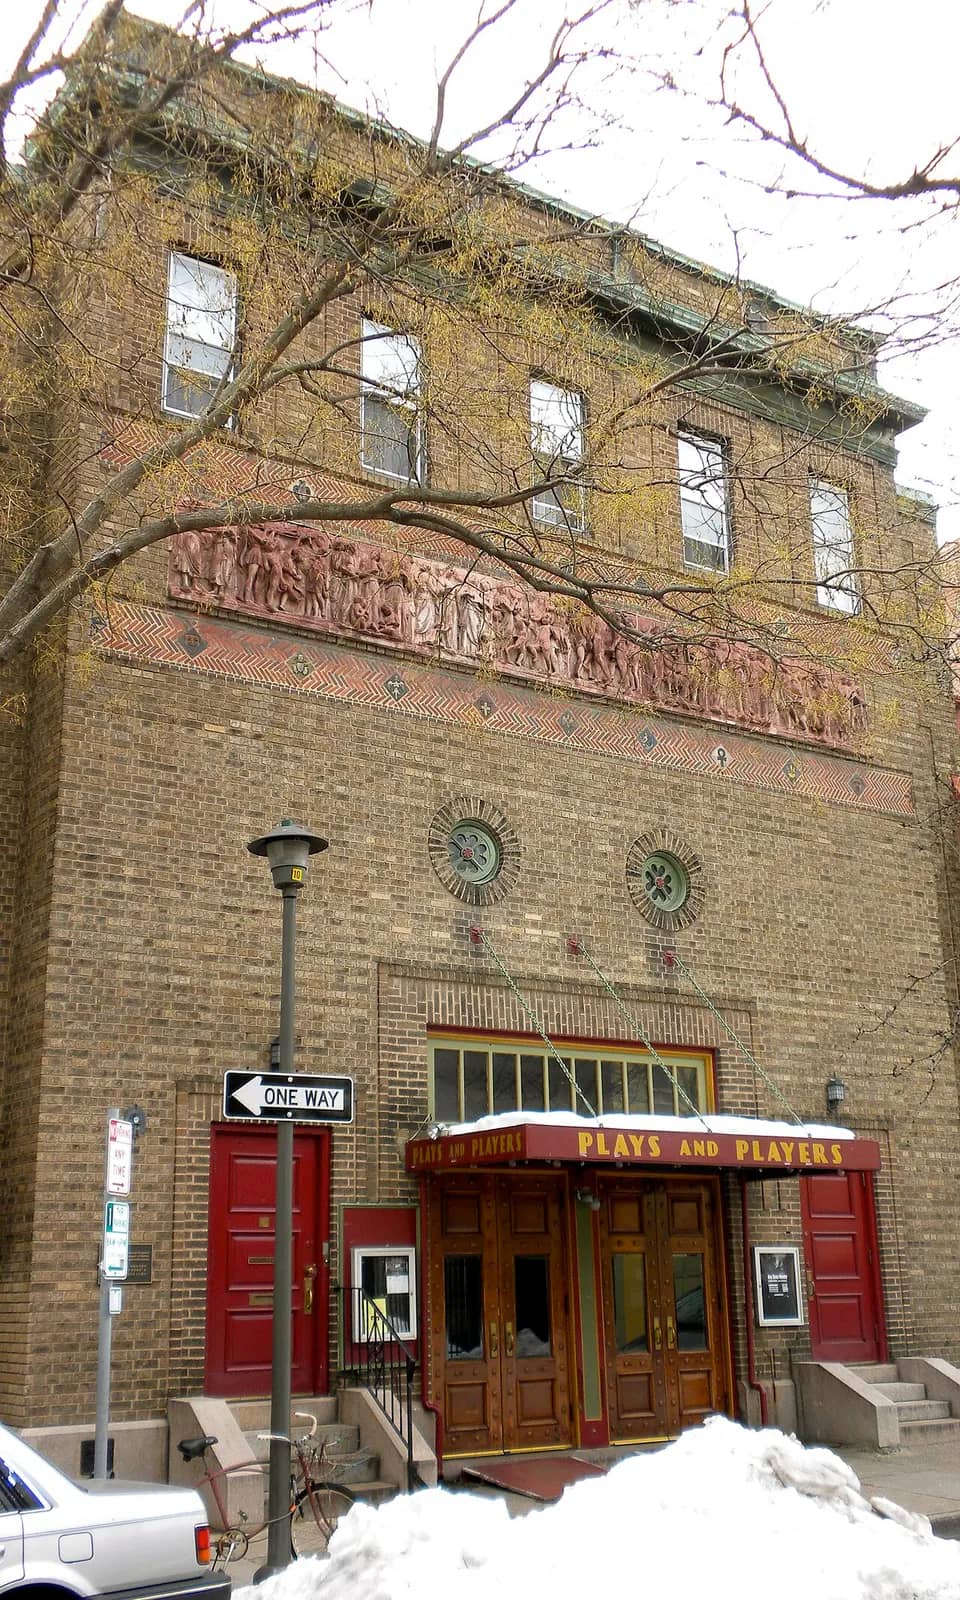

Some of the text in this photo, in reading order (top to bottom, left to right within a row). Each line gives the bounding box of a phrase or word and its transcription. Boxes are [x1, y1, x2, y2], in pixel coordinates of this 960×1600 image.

[293, 870, 301, 880] 10
[264, 1087, 339, 1108] ONE WAY
[114, 1149, 125, 1160] ANY
[412, 1132, 522, 1165] PLAYS AND PLAYERS
[578, 1131, 843, 1165] PLAYS AND PLAYERS
[113, 1164, 126, 1177] TIME
